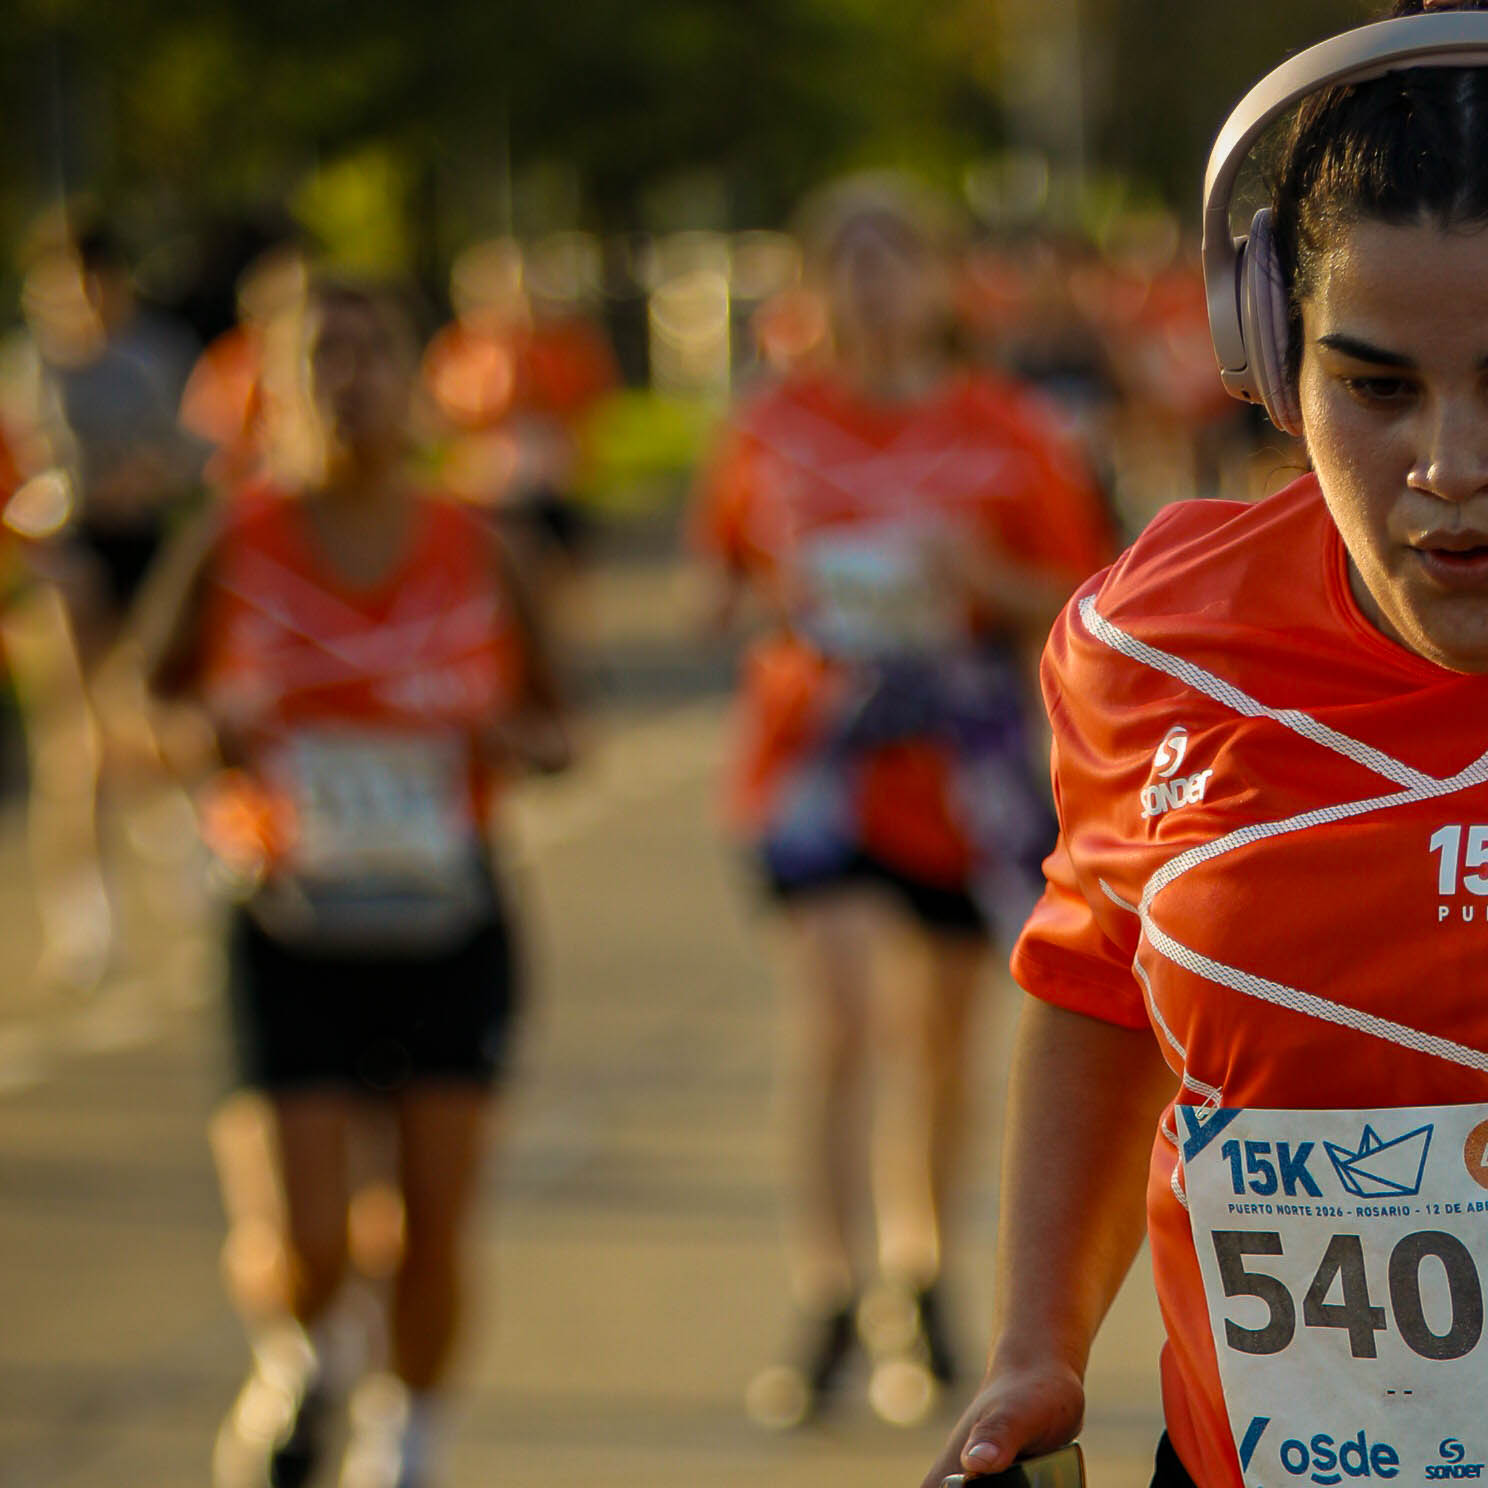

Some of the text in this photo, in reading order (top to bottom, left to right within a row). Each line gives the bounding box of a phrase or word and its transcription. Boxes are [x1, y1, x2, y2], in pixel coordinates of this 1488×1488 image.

[1221, 1139, 1323, 1198] 15K
[1228, 1203, 1273, 1215] PUERTO
[1276, 1205, 1313, 1217] NORTE
[1316, 1205, 1344, 1217] 2026
[1356, 1206, 1410, 1217] ROSARIO
[1426, 1204, 1440, 1215] 12
[1445, 1203, 1462, 1214] DE
[1280, 1430, 1400, 1480] osde
